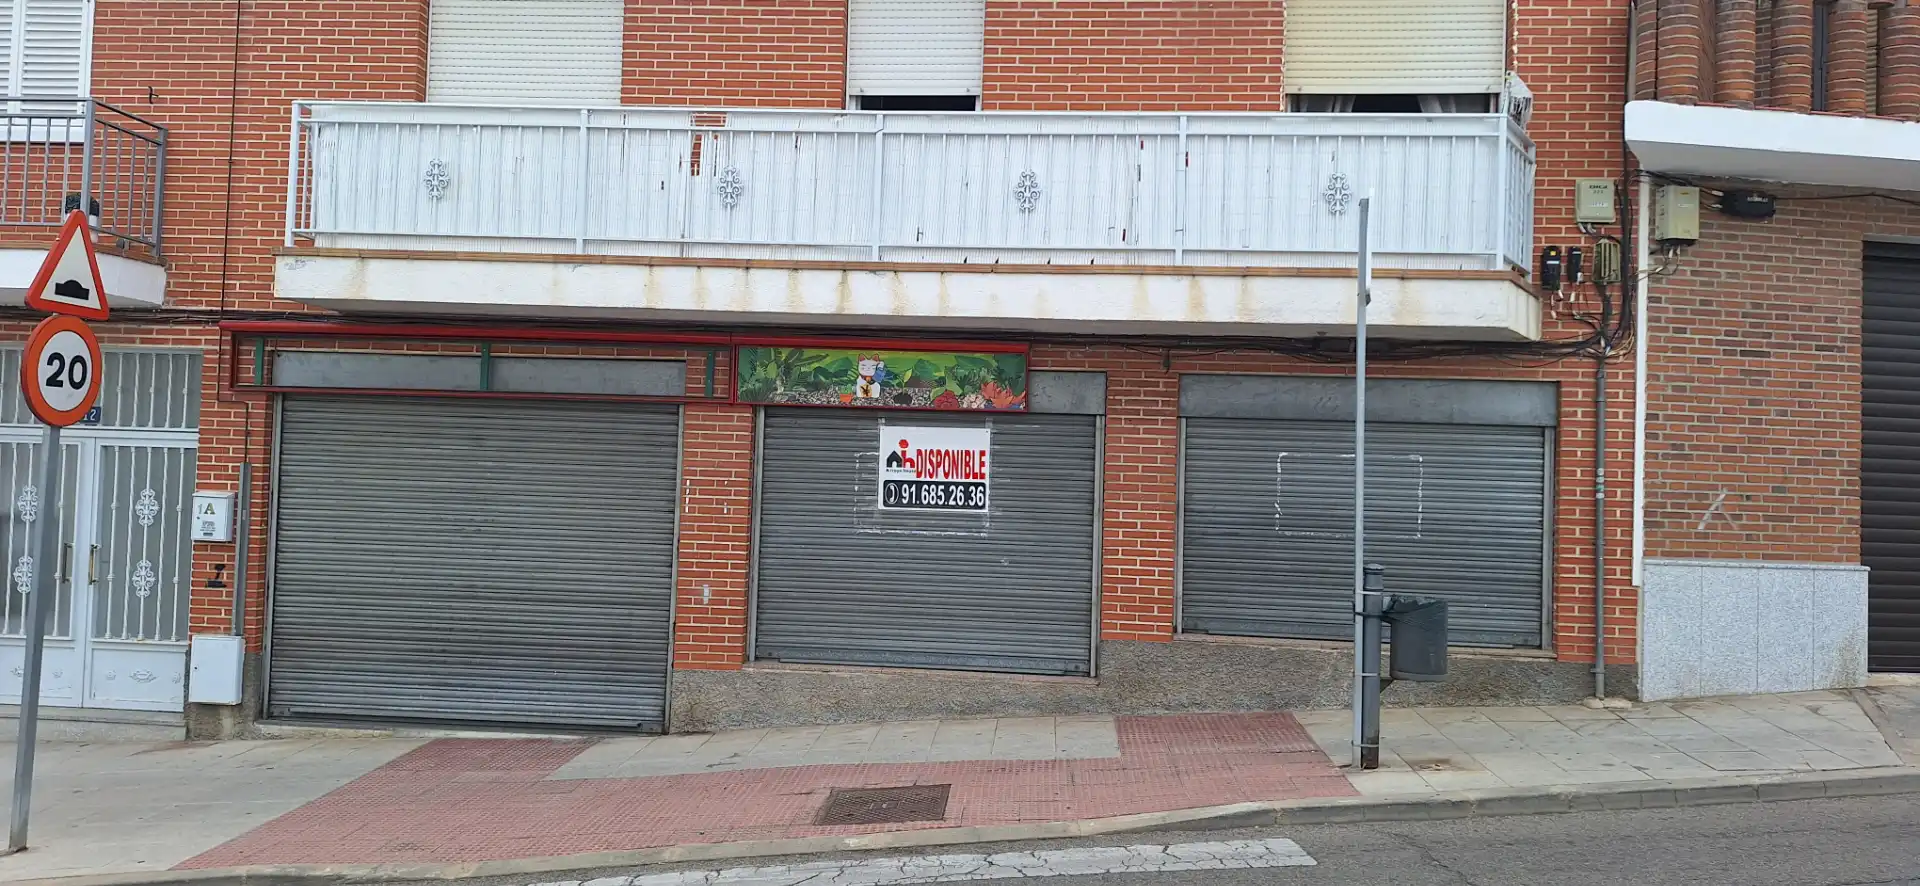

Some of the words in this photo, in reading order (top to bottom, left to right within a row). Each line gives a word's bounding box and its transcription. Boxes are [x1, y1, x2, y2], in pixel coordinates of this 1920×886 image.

[45, 352, 88, 390] 20
[916, 449, 986, 479] DISPONIBLE
[901, 484, 984, 506] 91.685.26.36
